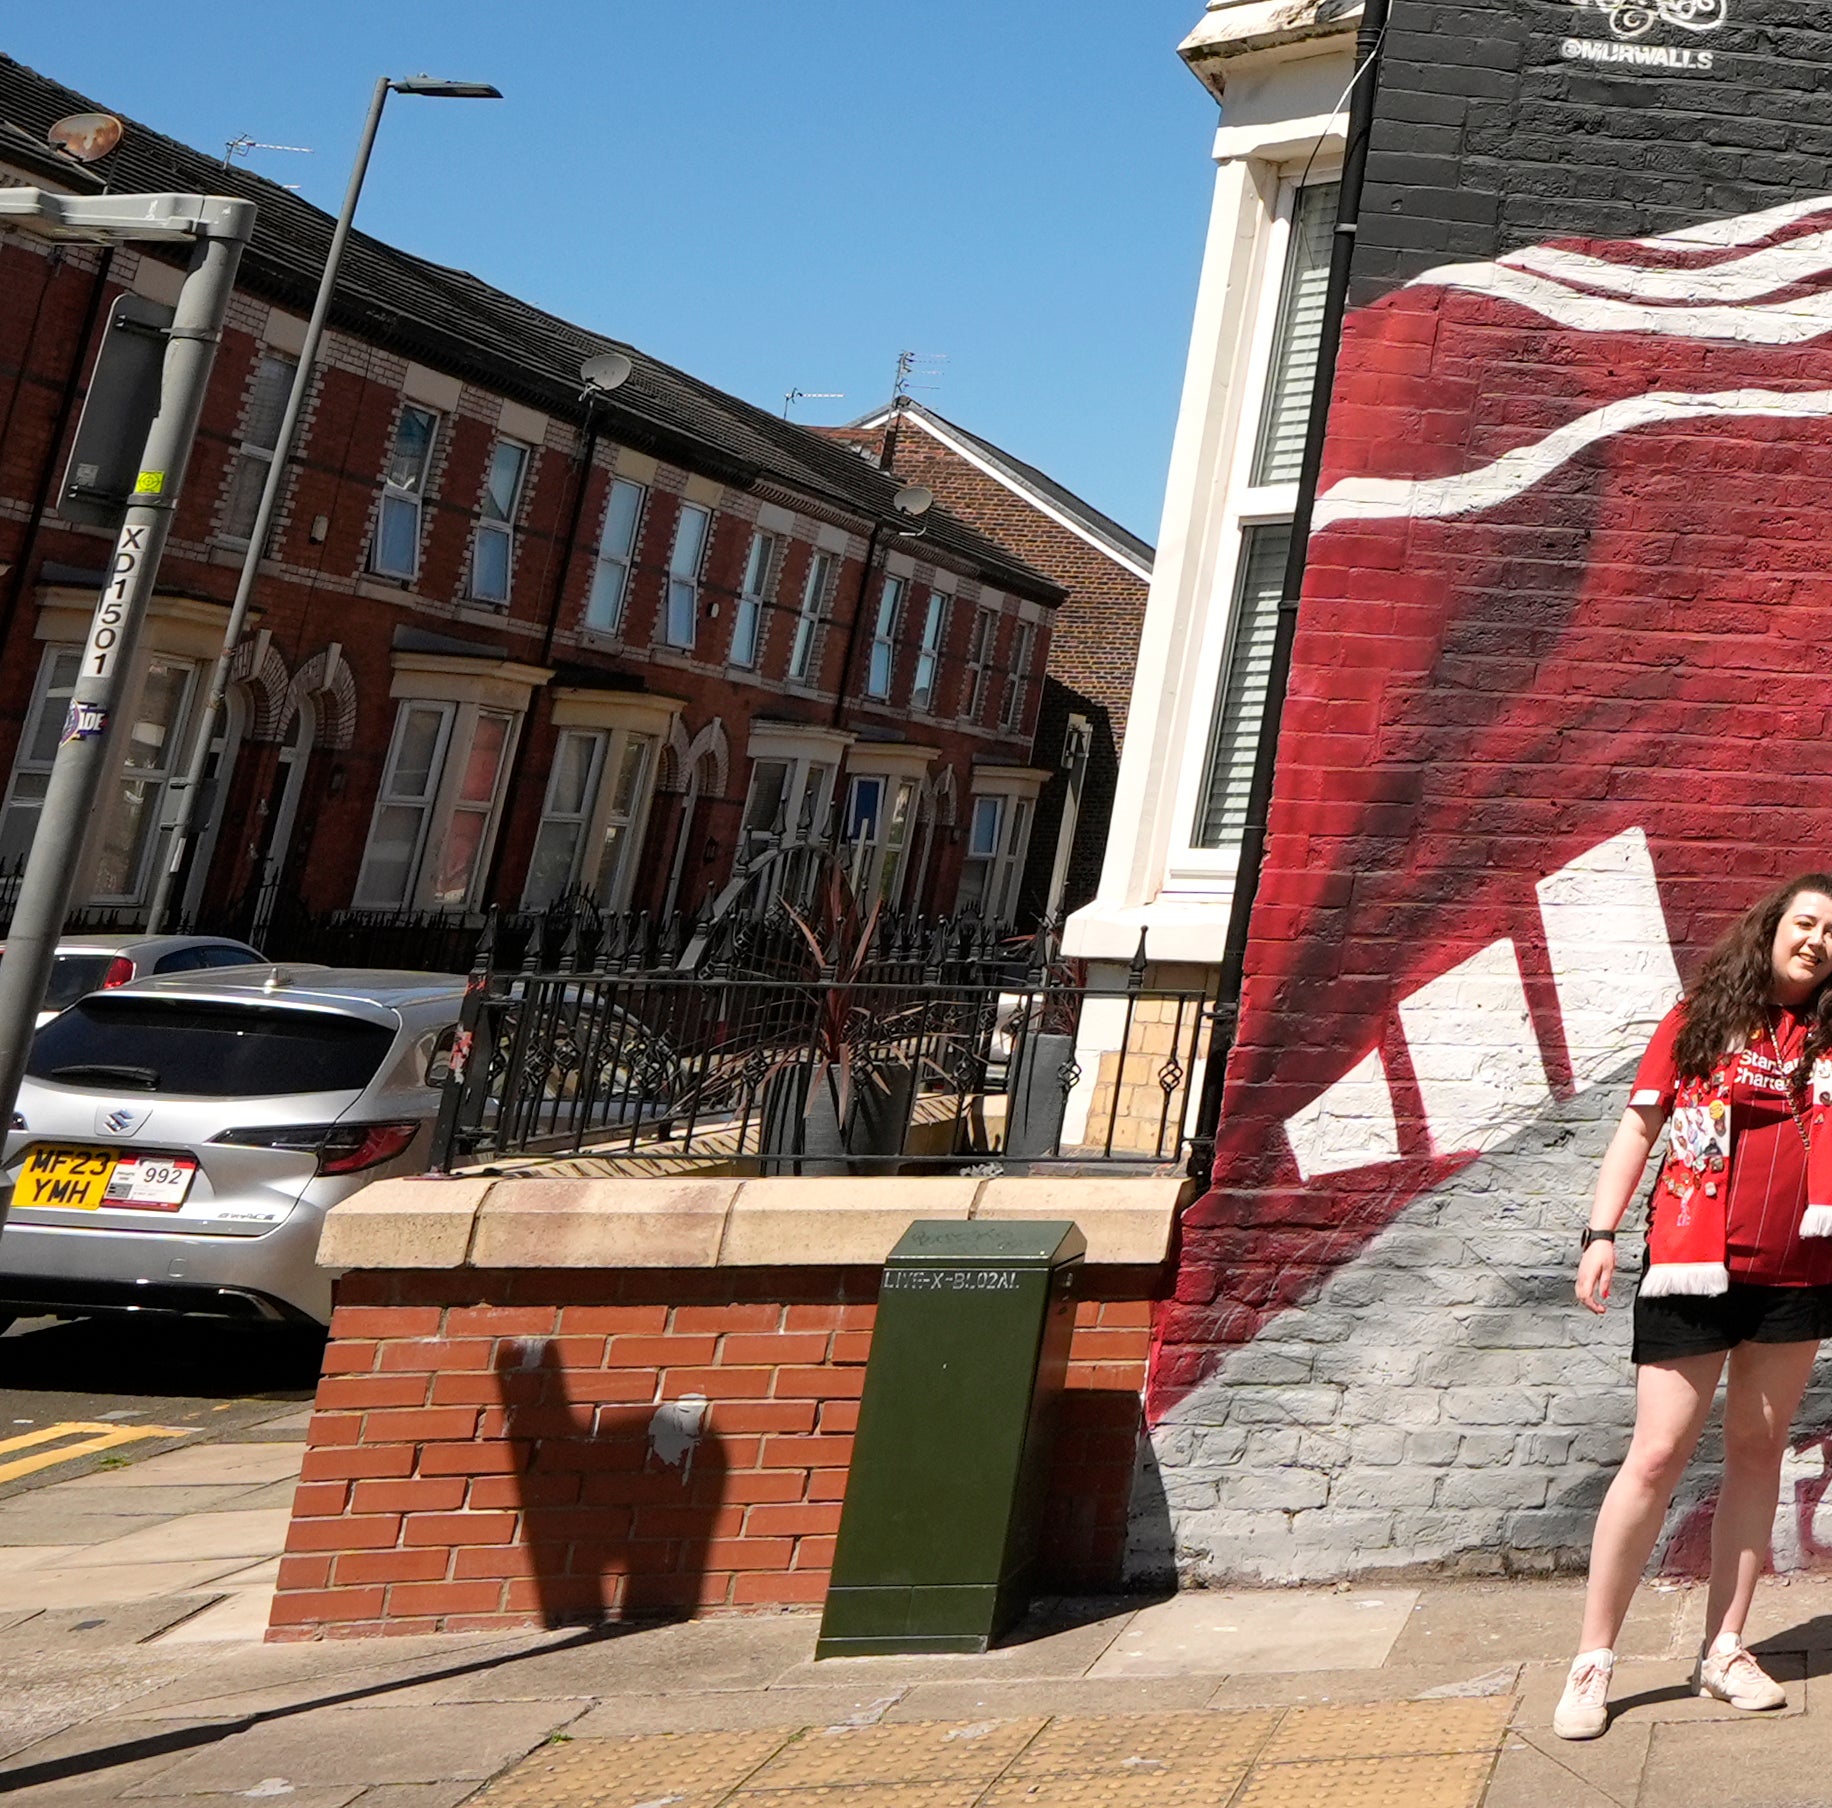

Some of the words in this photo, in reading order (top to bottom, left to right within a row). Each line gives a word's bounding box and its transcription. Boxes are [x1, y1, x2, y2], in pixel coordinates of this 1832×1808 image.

[93, 528, 144, 675] XD1501
[30, 1148, 111, 1176] MF23
[144, 1167, 182, 1185] 992
[33, 1178, 91, 1204] YMH
